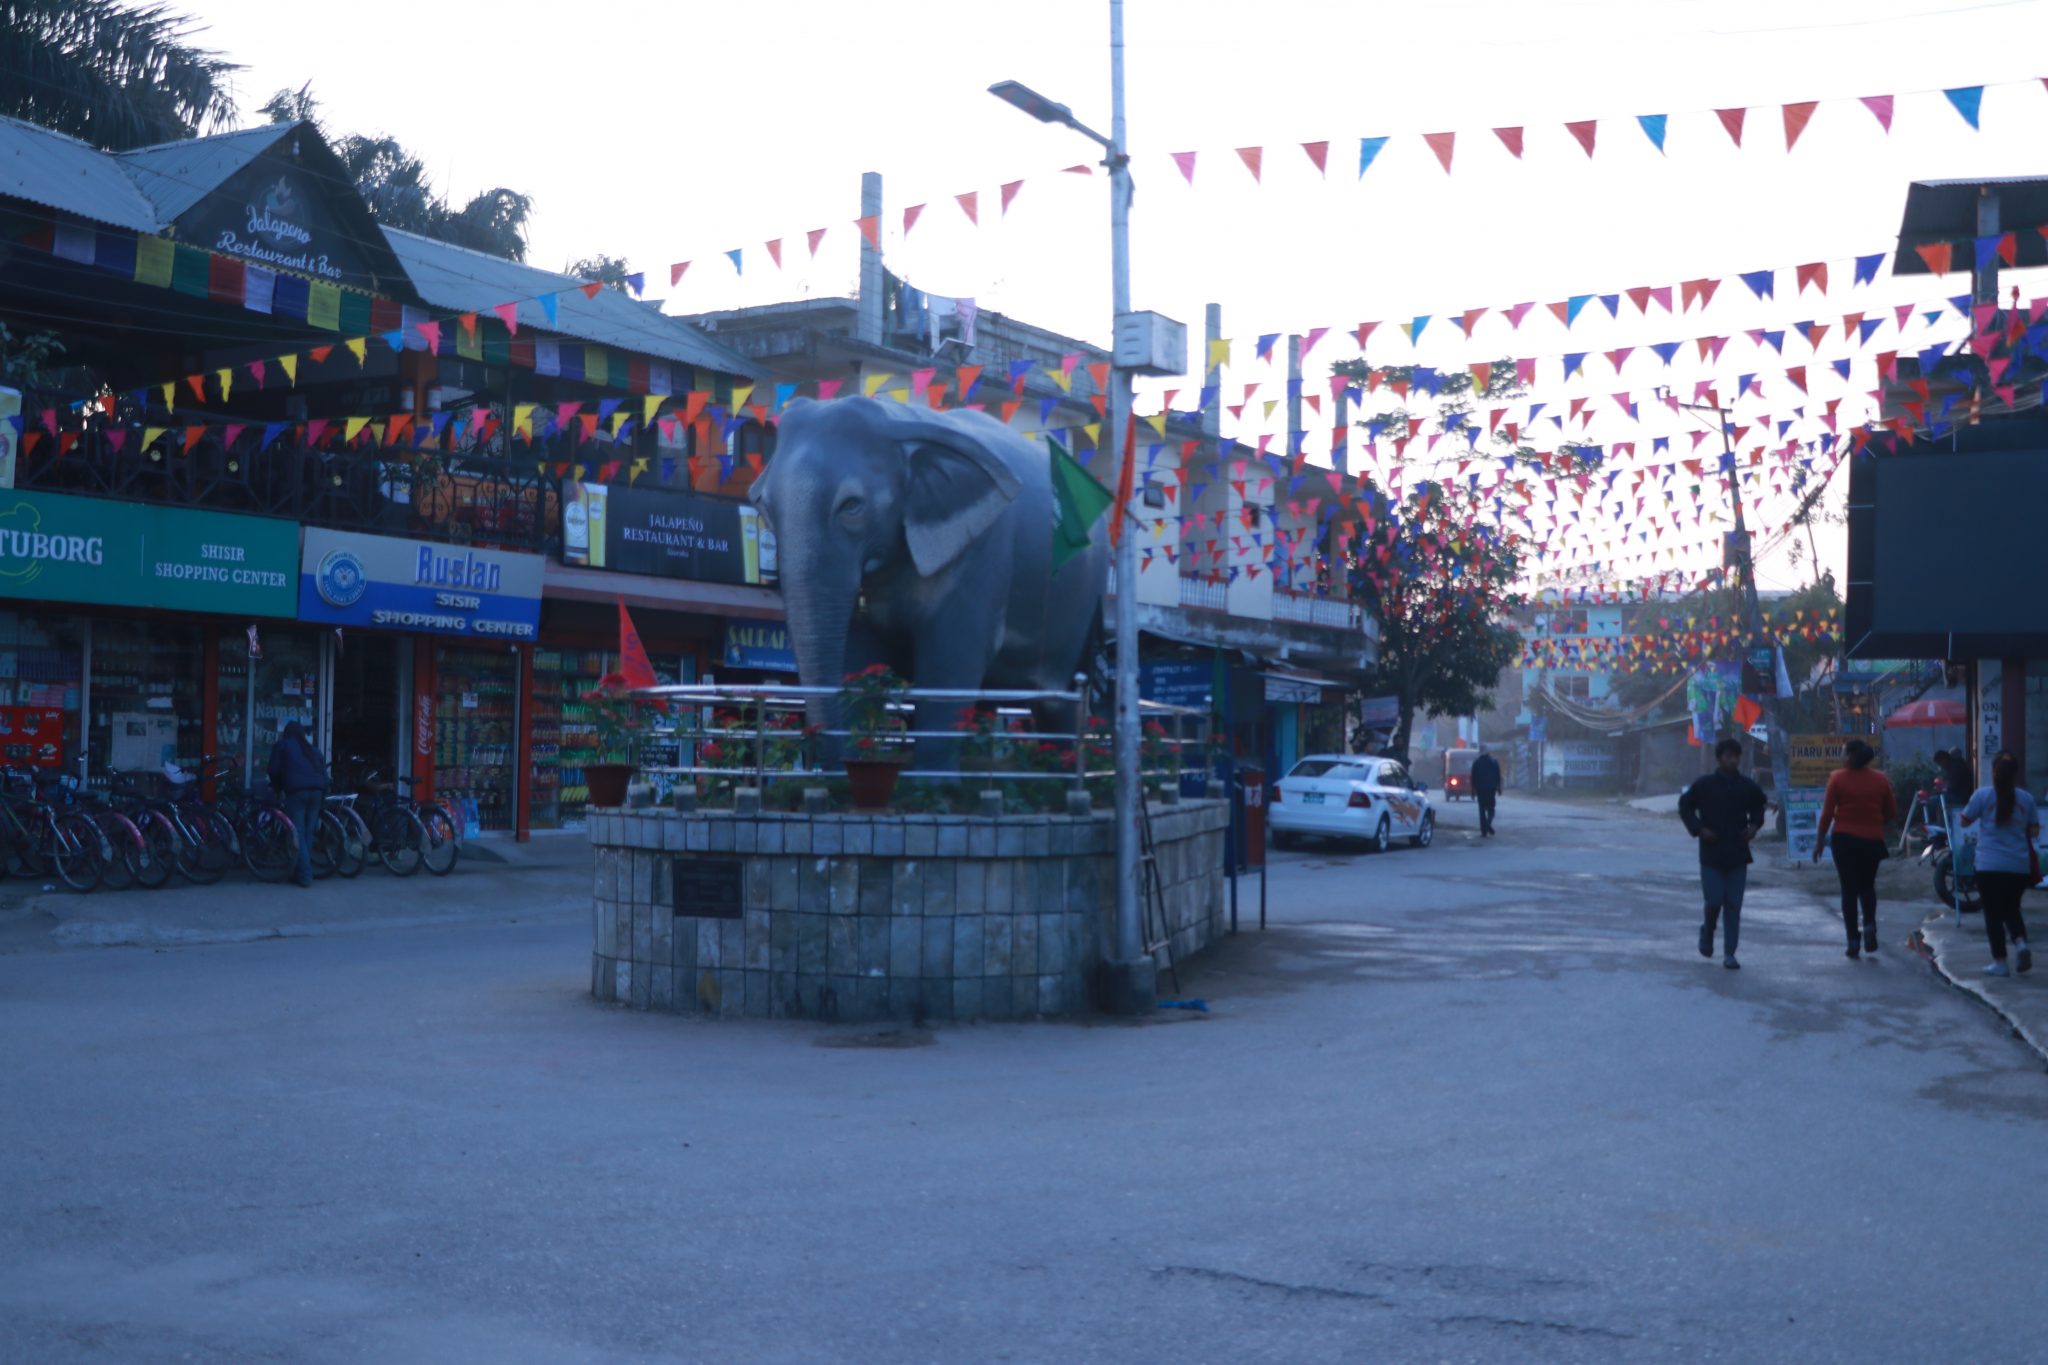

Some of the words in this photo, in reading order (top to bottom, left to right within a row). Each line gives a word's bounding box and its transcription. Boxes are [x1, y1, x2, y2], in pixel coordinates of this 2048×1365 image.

[246, 204, 312, 243] Jalapeno
[216, 231, 306, 269] Restaurant
[307, 257, 315, 272] &
[317, 255, 343, 279] Bar
[201, 543, 246, 562] SHISIR
[623, 527, 696, 548] RESTAURANT
[696, 538, 705, 549] &
[707, 538, 729, 553] BAR
[155, 562, 229, 583] SHOPPING
[232, 570, 287, 588] CENTER
[416, 543, 501, 592] Ruslan
[436, 592, 481, 610] SISIR
[372, 609, 466, 630] SHOPPING
[472, 619, 533, 637] CENTER
[1982, 703, 1999, 712] ON
